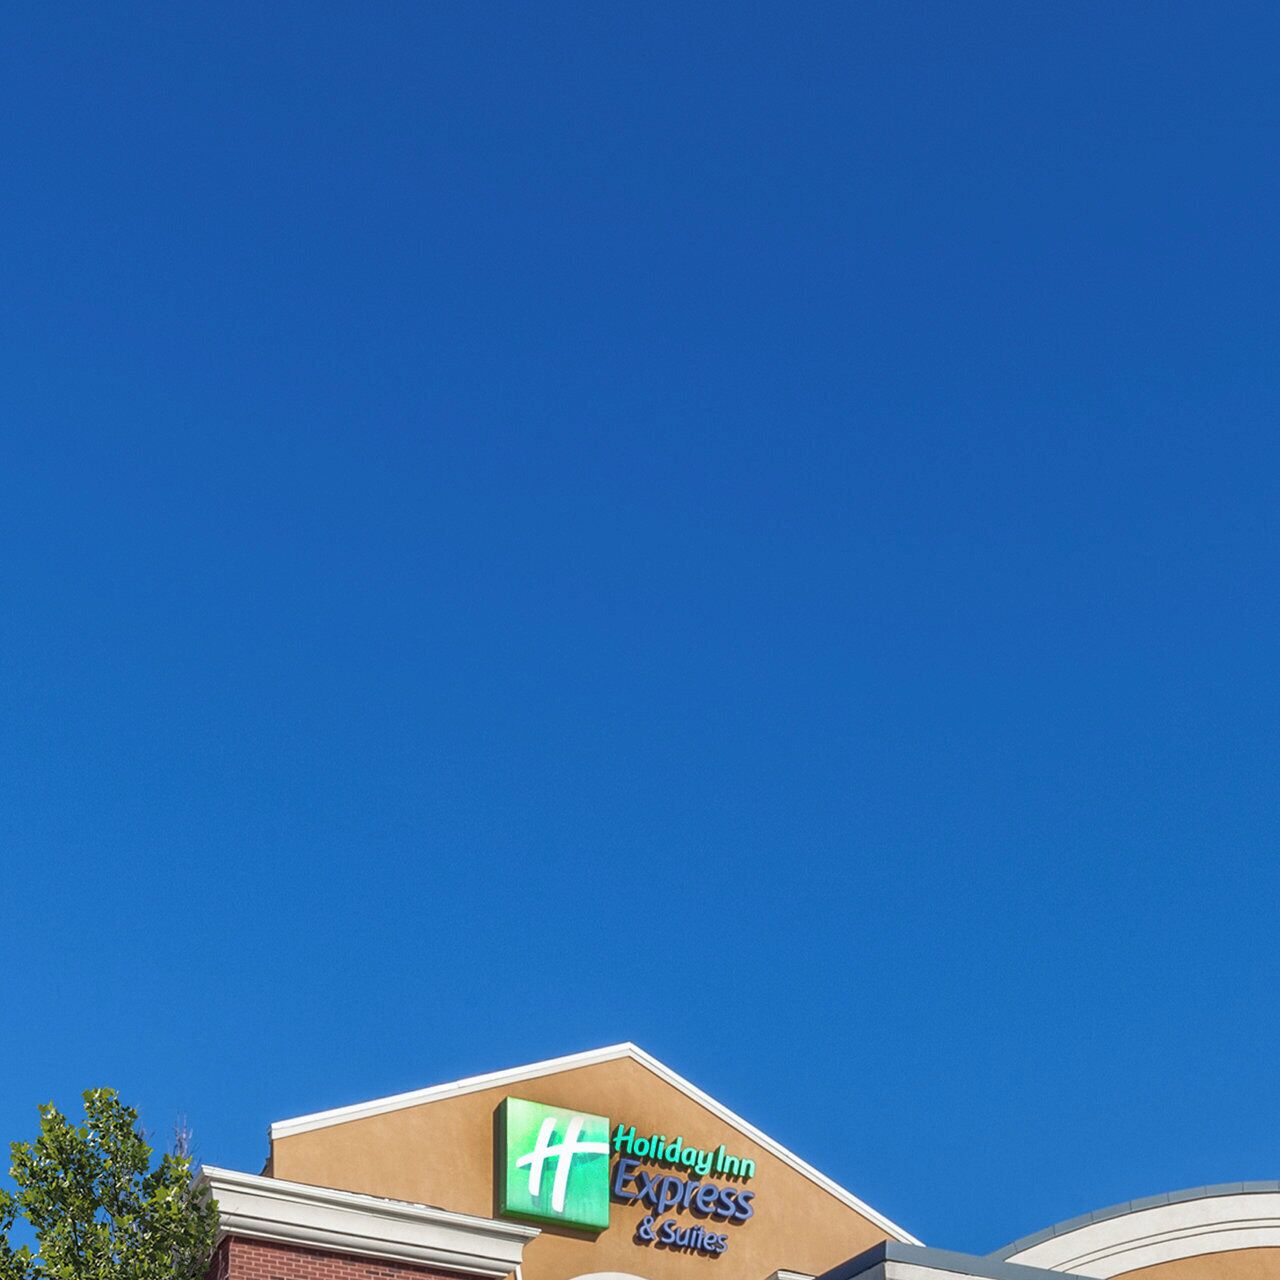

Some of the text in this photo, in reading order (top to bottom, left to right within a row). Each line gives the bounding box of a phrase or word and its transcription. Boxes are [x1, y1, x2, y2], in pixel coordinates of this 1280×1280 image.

[613, 1123, 756, 1178] Holiday Inn
[614, 1158, 755, 1221] Express
[639, 1216, 728, 1253] & Suites
